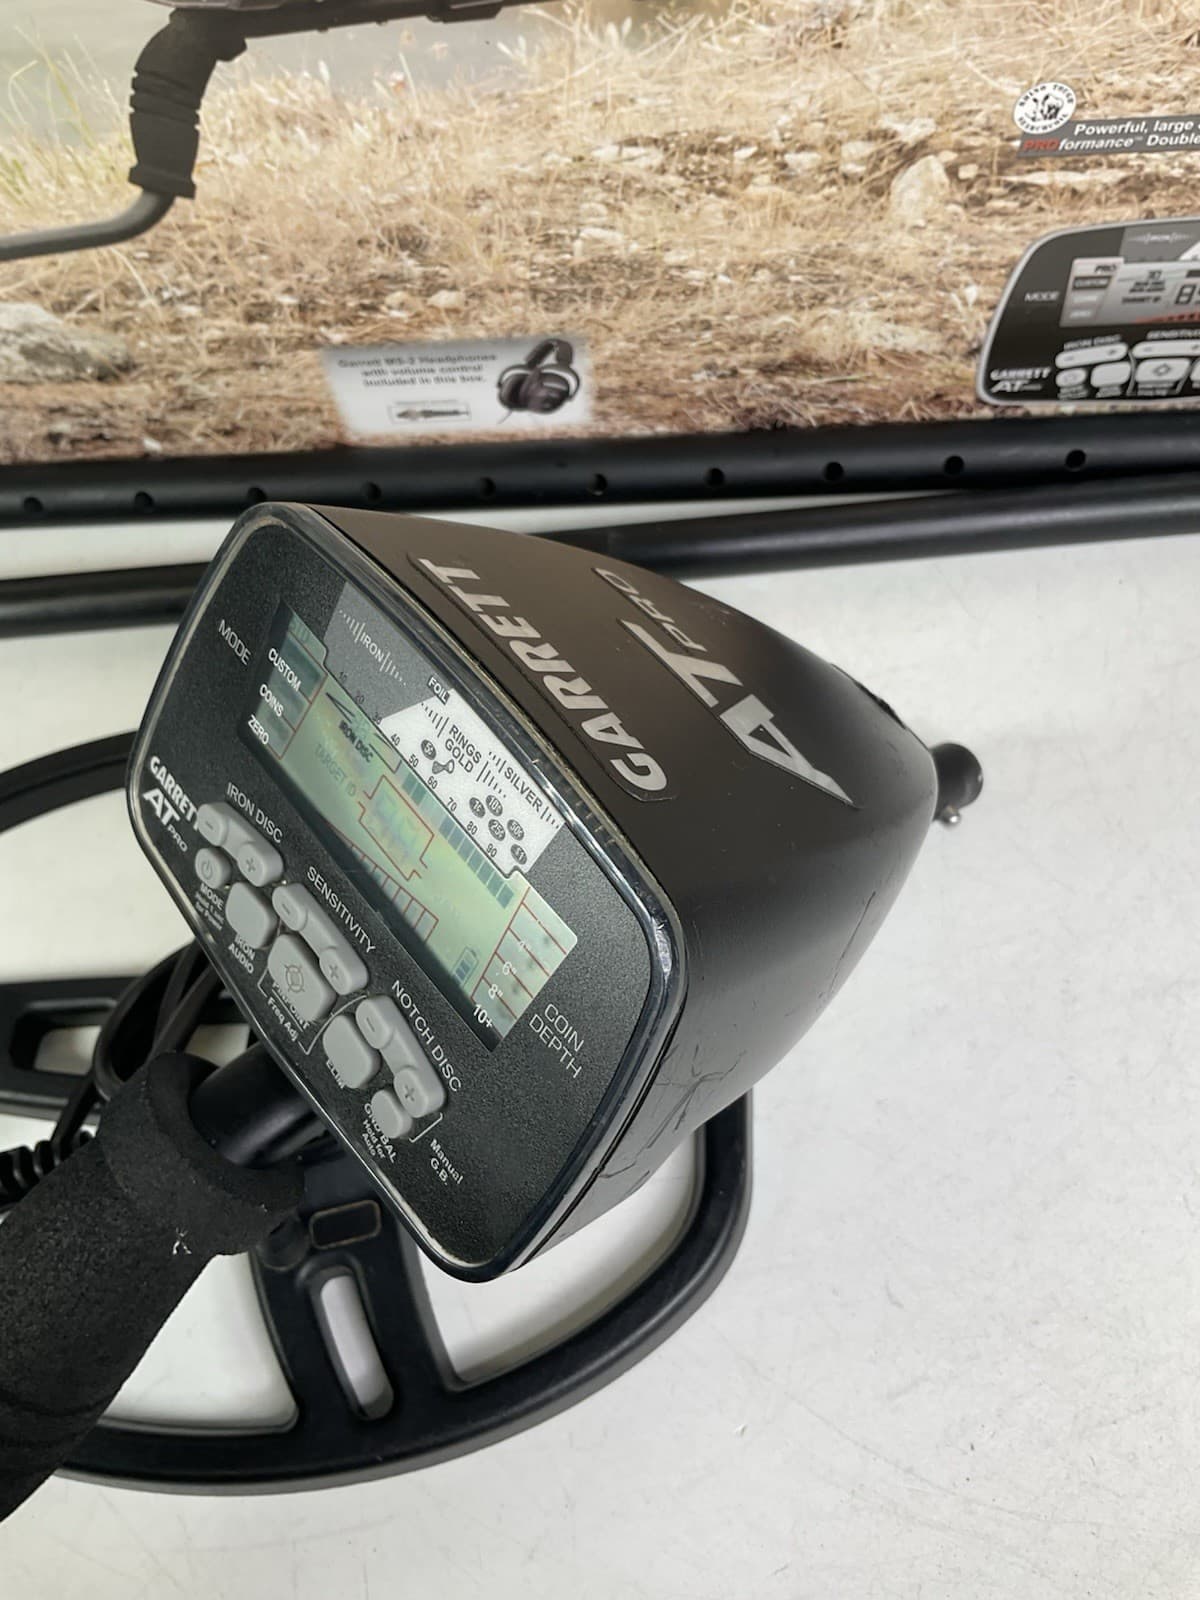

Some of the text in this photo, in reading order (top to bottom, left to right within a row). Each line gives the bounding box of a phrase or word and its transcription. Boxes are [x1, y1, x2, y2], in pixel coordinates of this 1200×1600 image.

[1074, 120, 1193, 136] Powerful, large
[1024, 291, 1060, 302] MODE
[419, 354, 497, 366] Headphones
[439, 364, 484, 374] control
[594, 567, 708, 652] PRO
[218, 619, 252, 665] MODE
[360, 632, 384, 662] IRON
[268, 648, 302, 692] CUSTOM
[418, 558, 668, 792] GARRETT
[260, 684, 285, 717] COINS
[428, 677, 450, 705] FOIL
[248, 714, 269, 745] ZERO
[391, 733, 400, 746] 40
[449, 725, 482, 764] RINGS
[408, 755, 419, 768] 50
[445, 739, 474, 772] GOLD
[427, 776, 438, 789] 60
[504, 767, 543, 812] SILVER
[142, 788, 188, 852] AT PRO
[227, 782, 283, 844] IRON DISC
[446, 797, 457, 812] 70
[466, 821, 478, 835] 80
[486, 843, 498, 858] 90
[201, 883, 224, 910] MODE
[307, 866, 376, 953] SENSITIVITY
[228, 943, 254, 974] AUDIO
[235, 934, 256, 961] IRON
[502, 962, 518, 976] 6"
[488, 983, 504, 999] 8"
[267, 998, 299, 1042] Freq Adj
[473, 1004, 493, 1028] 10+
[544, 1004, 584, 1051] COIN
[392, 980, 462, 1092] NOTCH DISC
[529, 1014, 582, 1079] DEPTH
[362, 1119, 386, 1159] Hold for
[362, 1132, 376, 1156] Auto
[379, 1132, 399, 1163] BAL
[430, 1138, 464, 1185] Manual
[430, 1158, 449, 1185] G.B.
